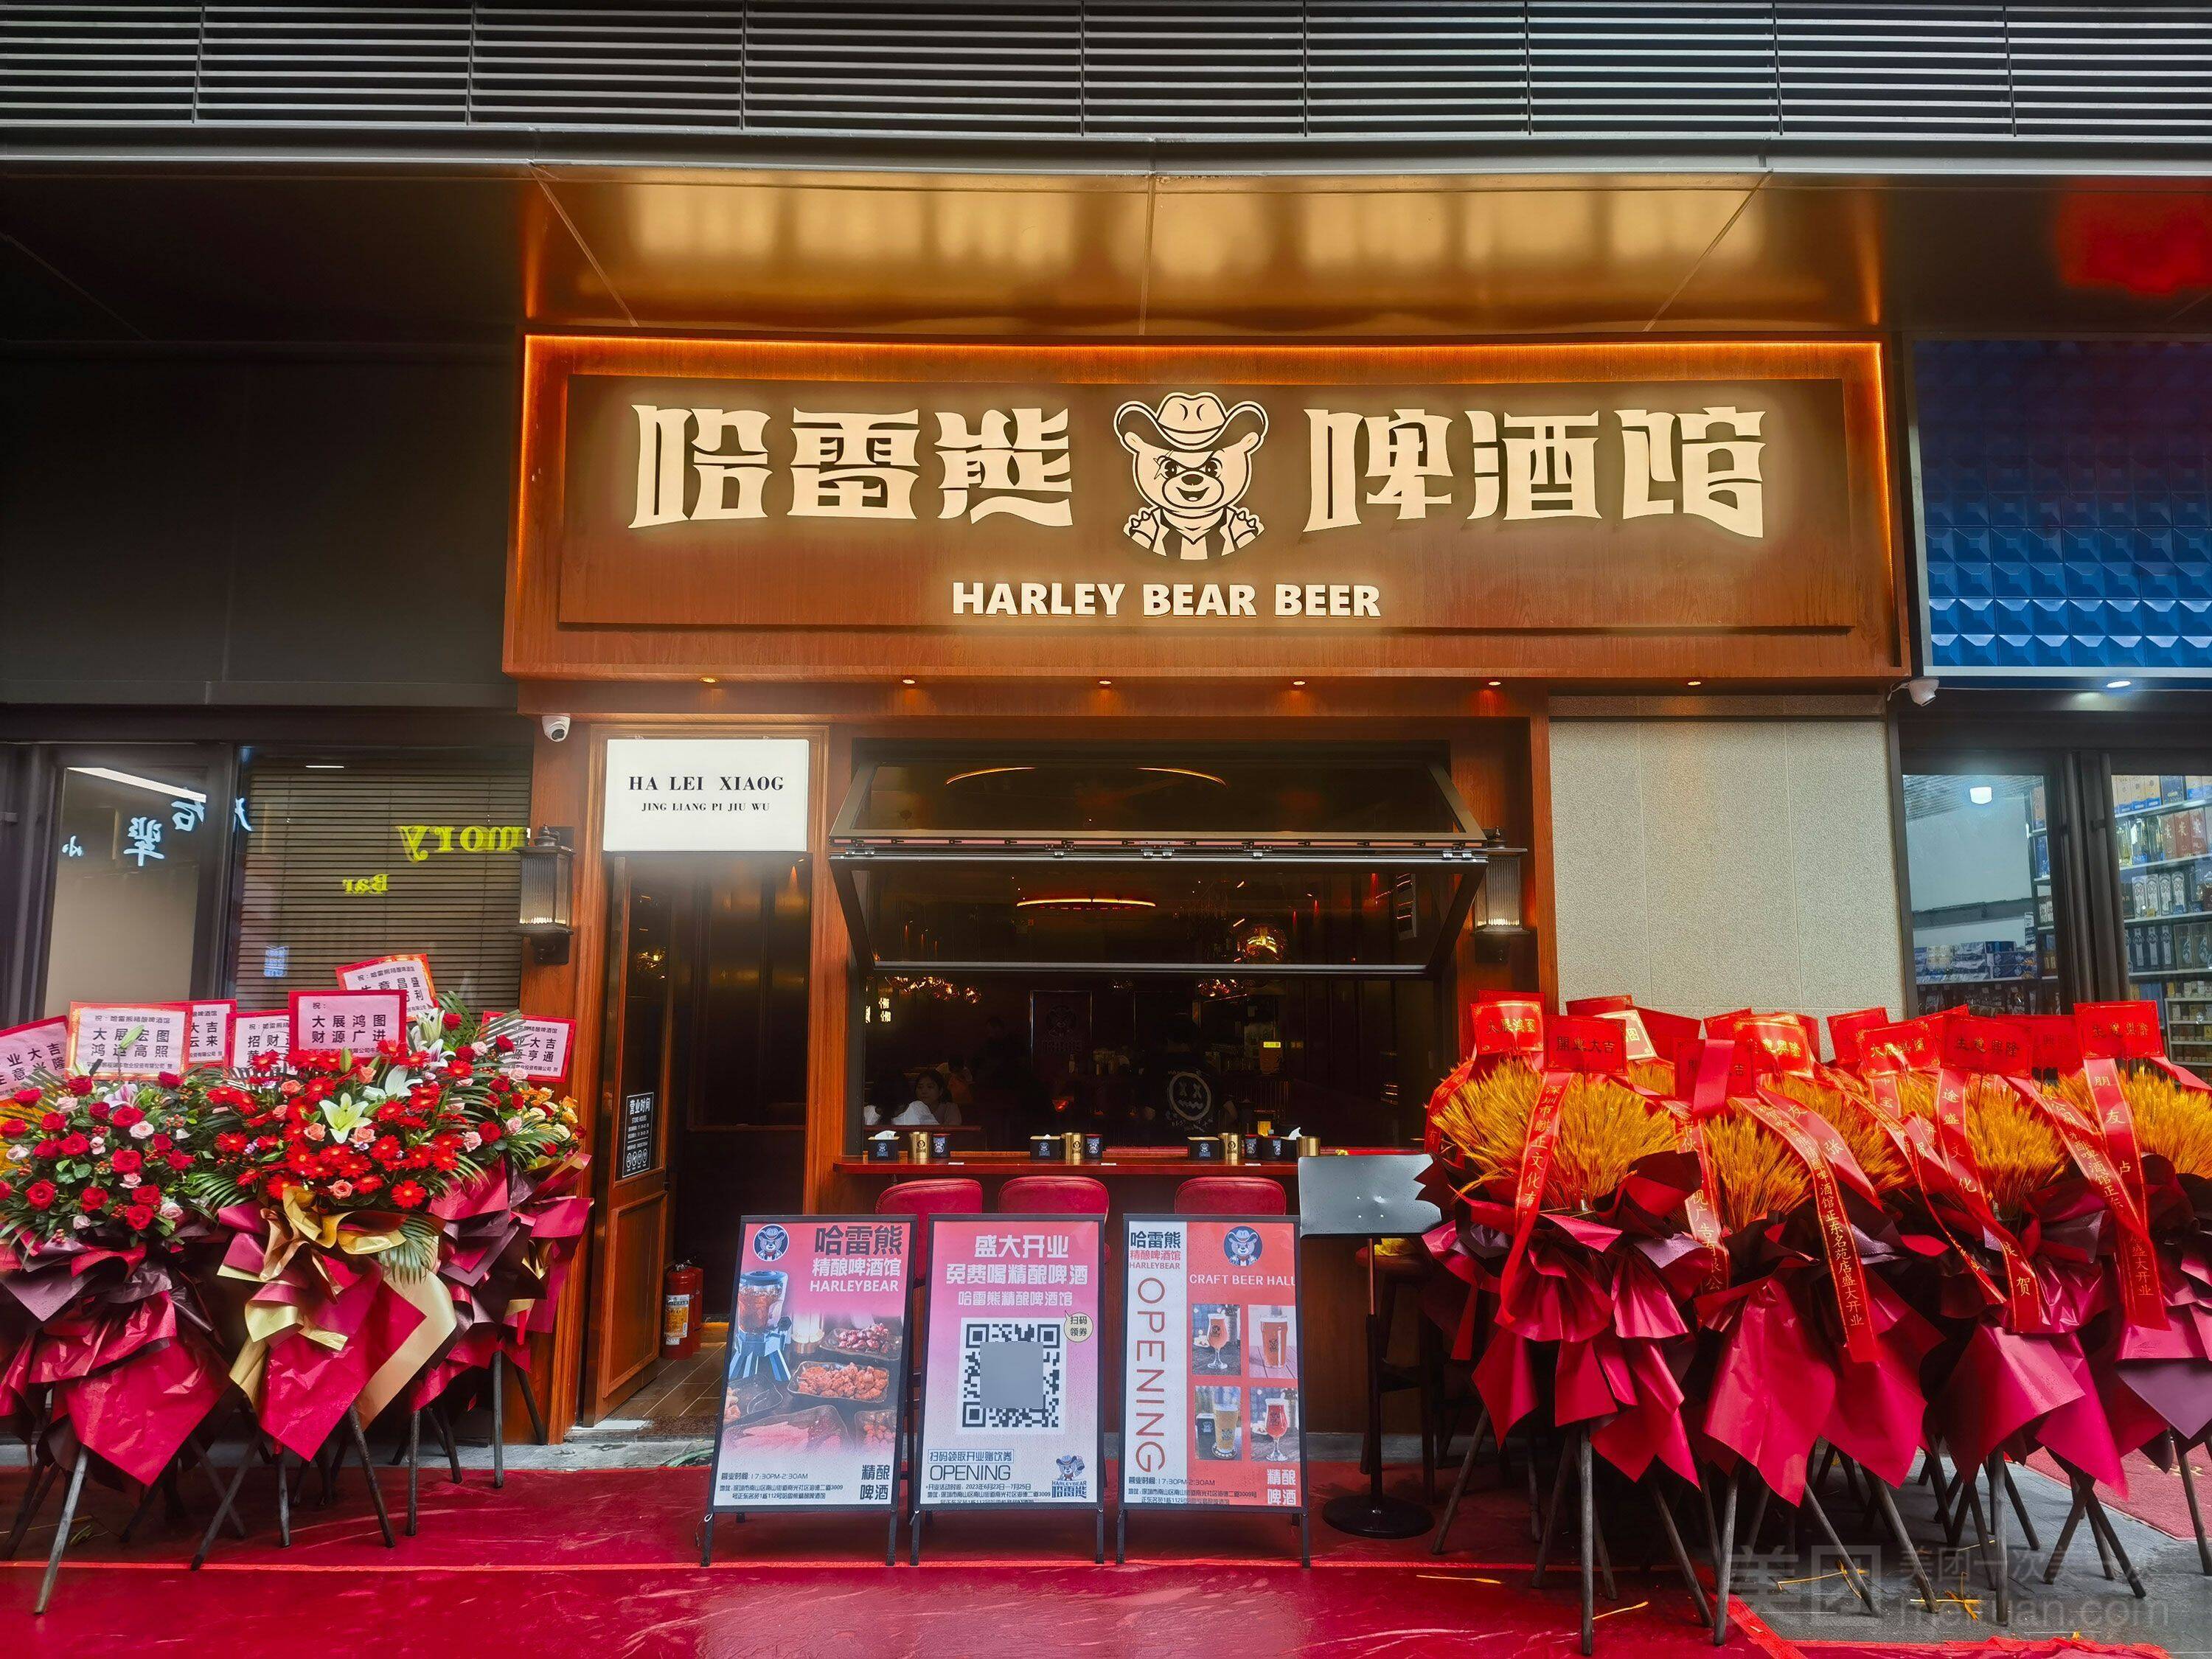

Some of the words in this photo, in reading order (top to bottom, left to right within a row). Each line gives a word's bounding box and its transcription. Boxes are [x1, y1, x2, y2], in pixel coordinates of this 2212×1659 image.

[628, 404, 1074, 529] 哈雷熊
[1303, 406, 1766, 538] 啤酒馆
[952, 581, 1126, 616] HARLEY
[1143, 583, 1256, 618] BEAR
[1274, 584, 1381, 618] BEER
[629, 776, 658, 790] HA
[669, 776, 703, 790] LEI
[720, 776, 784, 790] XIAOG
[641, 803, 667, 812] JING
[672, 803, 706, 811] LIANG
[712, 803, 723, 811] PI
[728, 803, 746, 812] JIU
[751, 803, 770, 811] WU
[312, 1014, 386, 1028] 大展鸿图
[92, 1028, 170, 1043] 大展宏图
[312, 1030, 386, 1043] 财源广进
[0, 1043, 60, 1067] 业大吉
[91, 1043, 168, 1057] 鸿运高照
[815, 1225, 902, 1256] 哈雷熊
[974, 1234, 1068, 1258] 盛大开业
[1130, 1231, 1181, 1249] 哈雷熊
[1130, 1249, 1181, 1261] 精酿啤酒馆
[812, 1257, 901, 1278] 精酿啤酒馆
[1129, 1262, 1180, 1270] HARLEYBEAR
[946, 1264, 1088, 1285] 免费喝精酿啤酒
[1189, 1273, 1228, 1284] CRAFT
[1232, 1275, 1263, 1285] BEER
[810, 1279, 899, 1293] HARLEYBEAR
[958, 1290, 1073, 1307] 哈雷熊精酿啤酒馆
[1070, 1315, 1088, 1325] 扫码
[1070, 1327, 1088, 1337] 领券
[1135, 1277, 1166, 1473] OPENING
[861, 1464, 890, 1481] 精酿
[930, 1464, 1011, 1481] OPENING
[1267, 1469, 1296, 1485] 精酿
[860, 1484, 888, 1500] 啤酒
[1052, 1486, 1087, 1498] 哈雷熊
[1267, 1489, 1296, 1505] 啤酒
